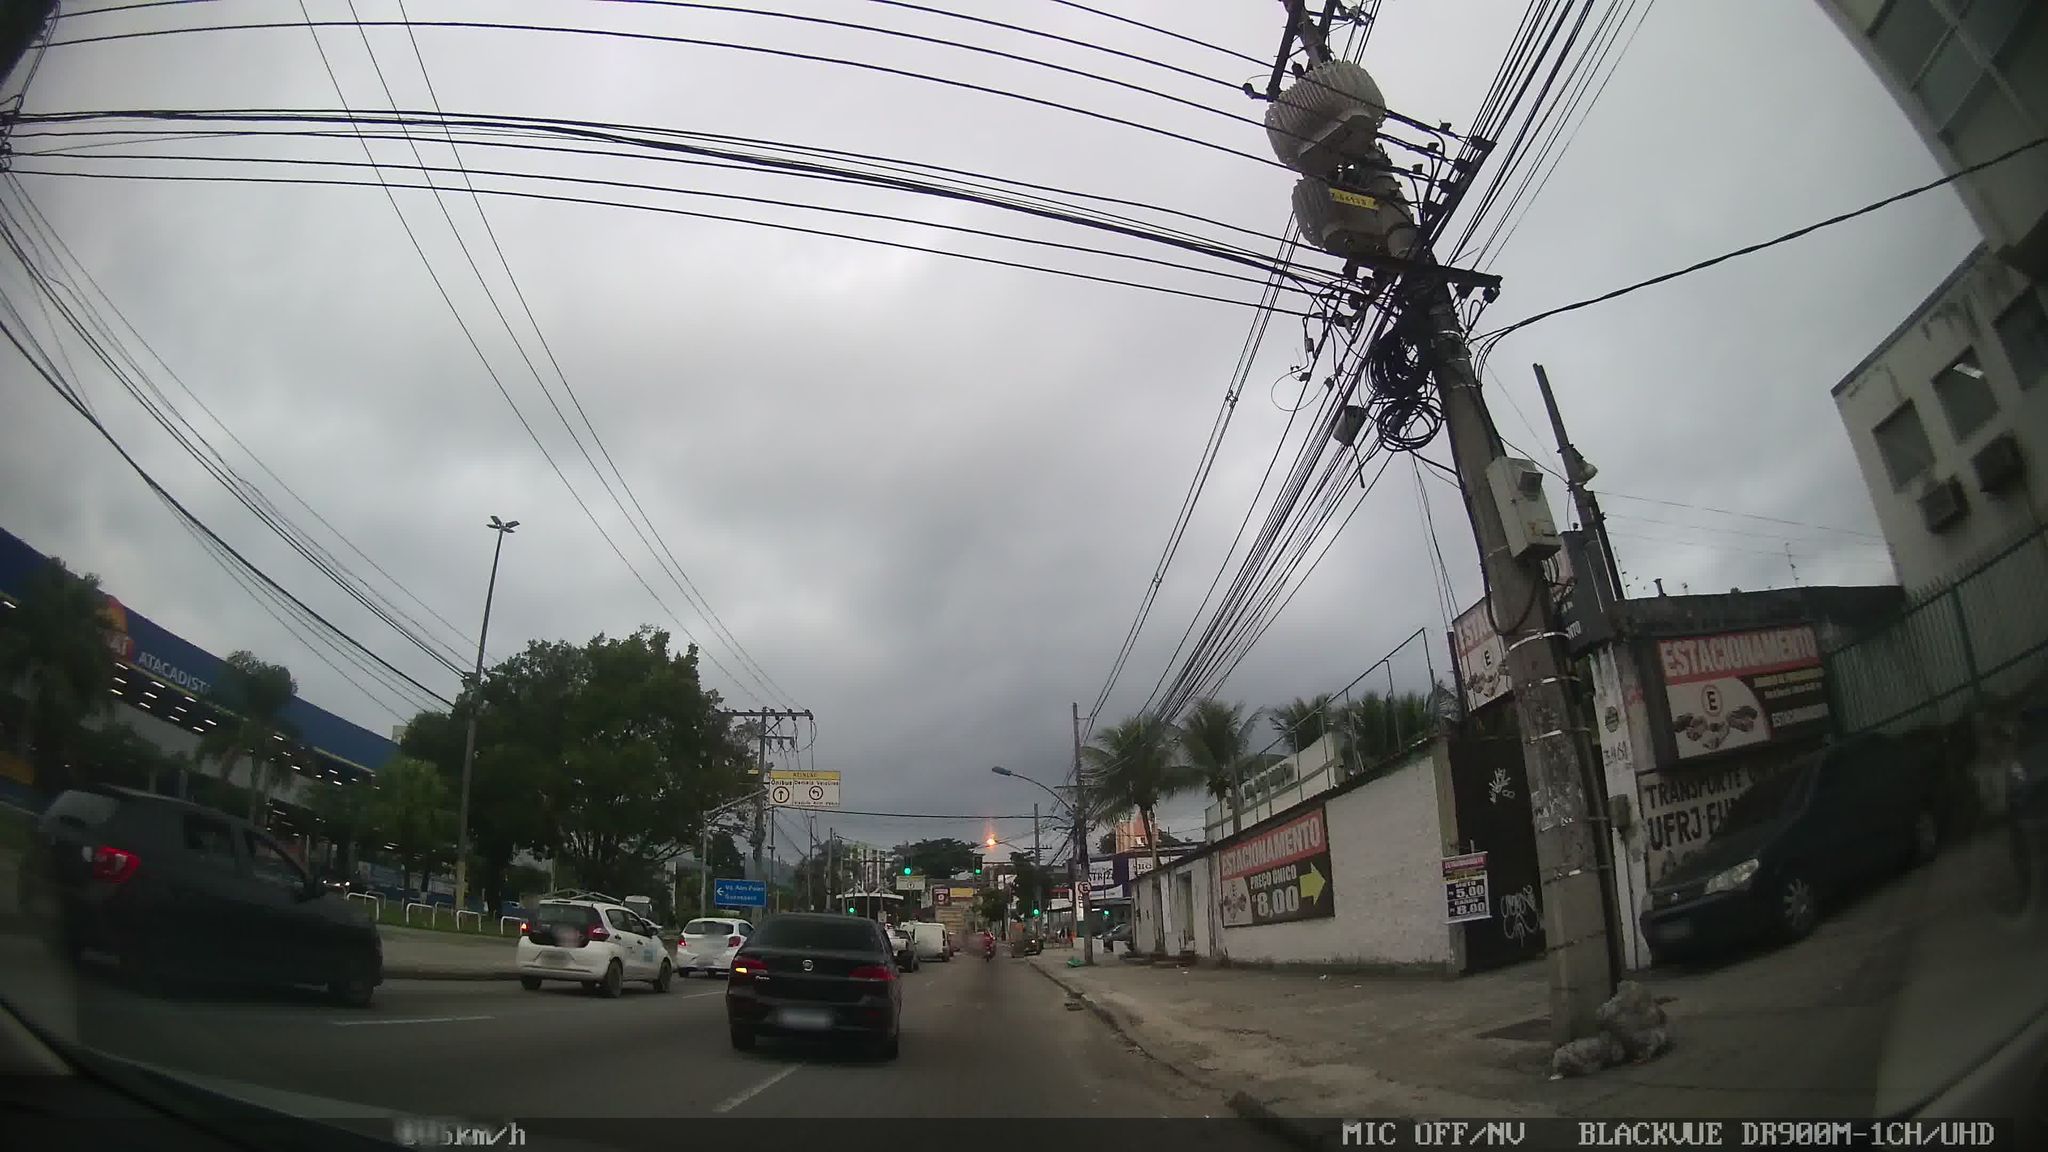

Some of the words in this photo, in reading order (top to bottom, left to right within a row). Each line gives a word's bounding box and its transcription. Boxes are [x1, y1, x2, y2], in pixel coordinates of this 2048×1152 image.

[1660, 626, 1818, 679] ESTACIONAMENTO
[1222, 817, 1322, 877] ESTACIONAMENTO
[1250, 871, 1273, 891] PREÇO
[1256, 885, 1300, 918] 8,00
